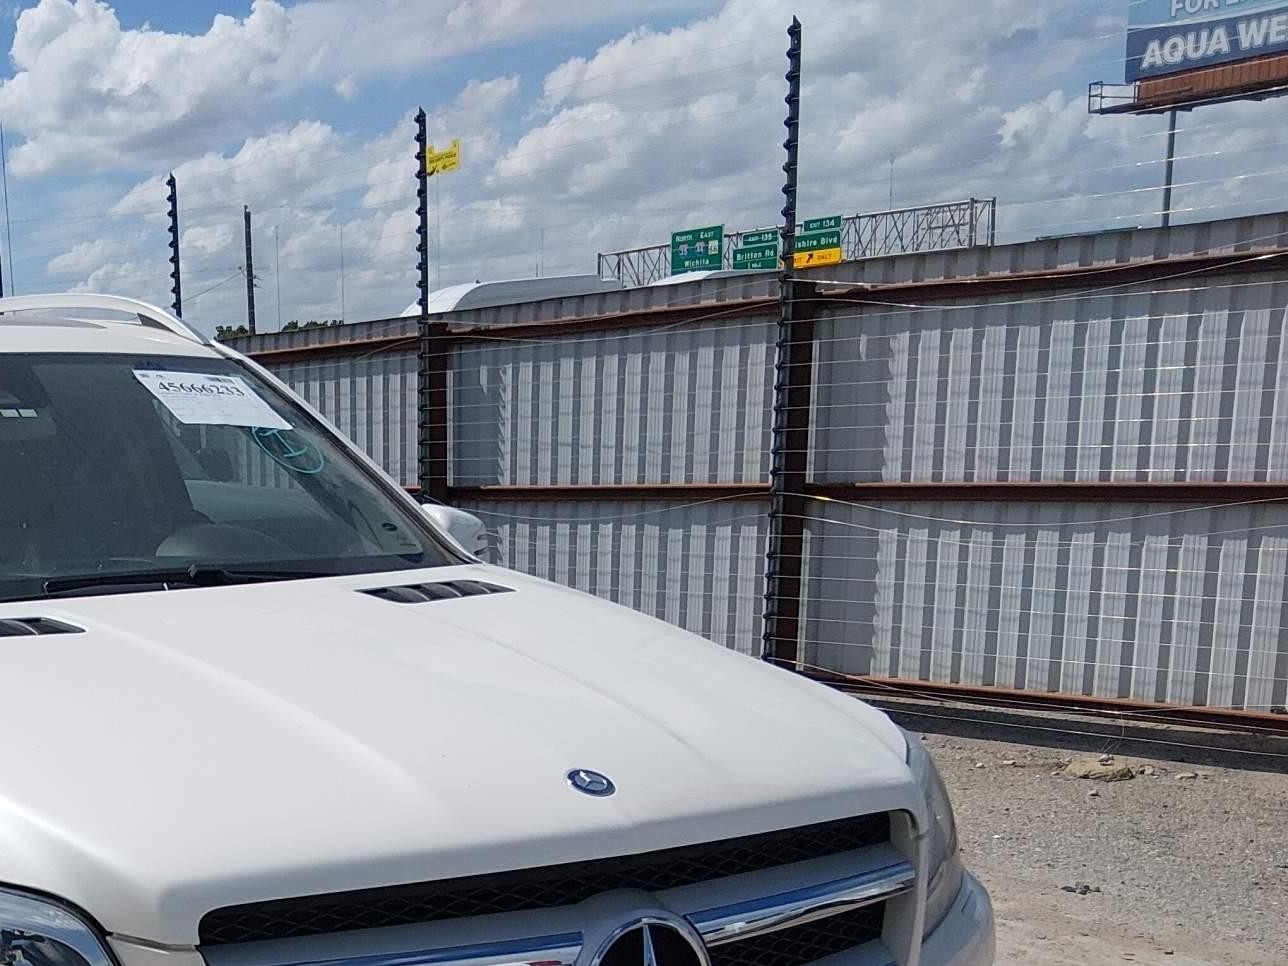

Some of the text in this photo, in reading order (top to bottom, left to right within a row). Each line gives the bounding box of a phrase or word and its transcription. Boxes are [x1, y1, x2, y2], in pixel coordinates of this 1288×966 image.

[1140, 27, 1230, 69] AQUA
[822, 218, 835, 228] 134
[699, 231, 714, 239] EAST
[761, 232, 773, 241] 135
[820, 236, 838, 246] Blvd
[736, 248, 774, 261] Britton Rd
[684, 258, 710, 267] Wichita
[158, 382, 245, 397] 45666233
